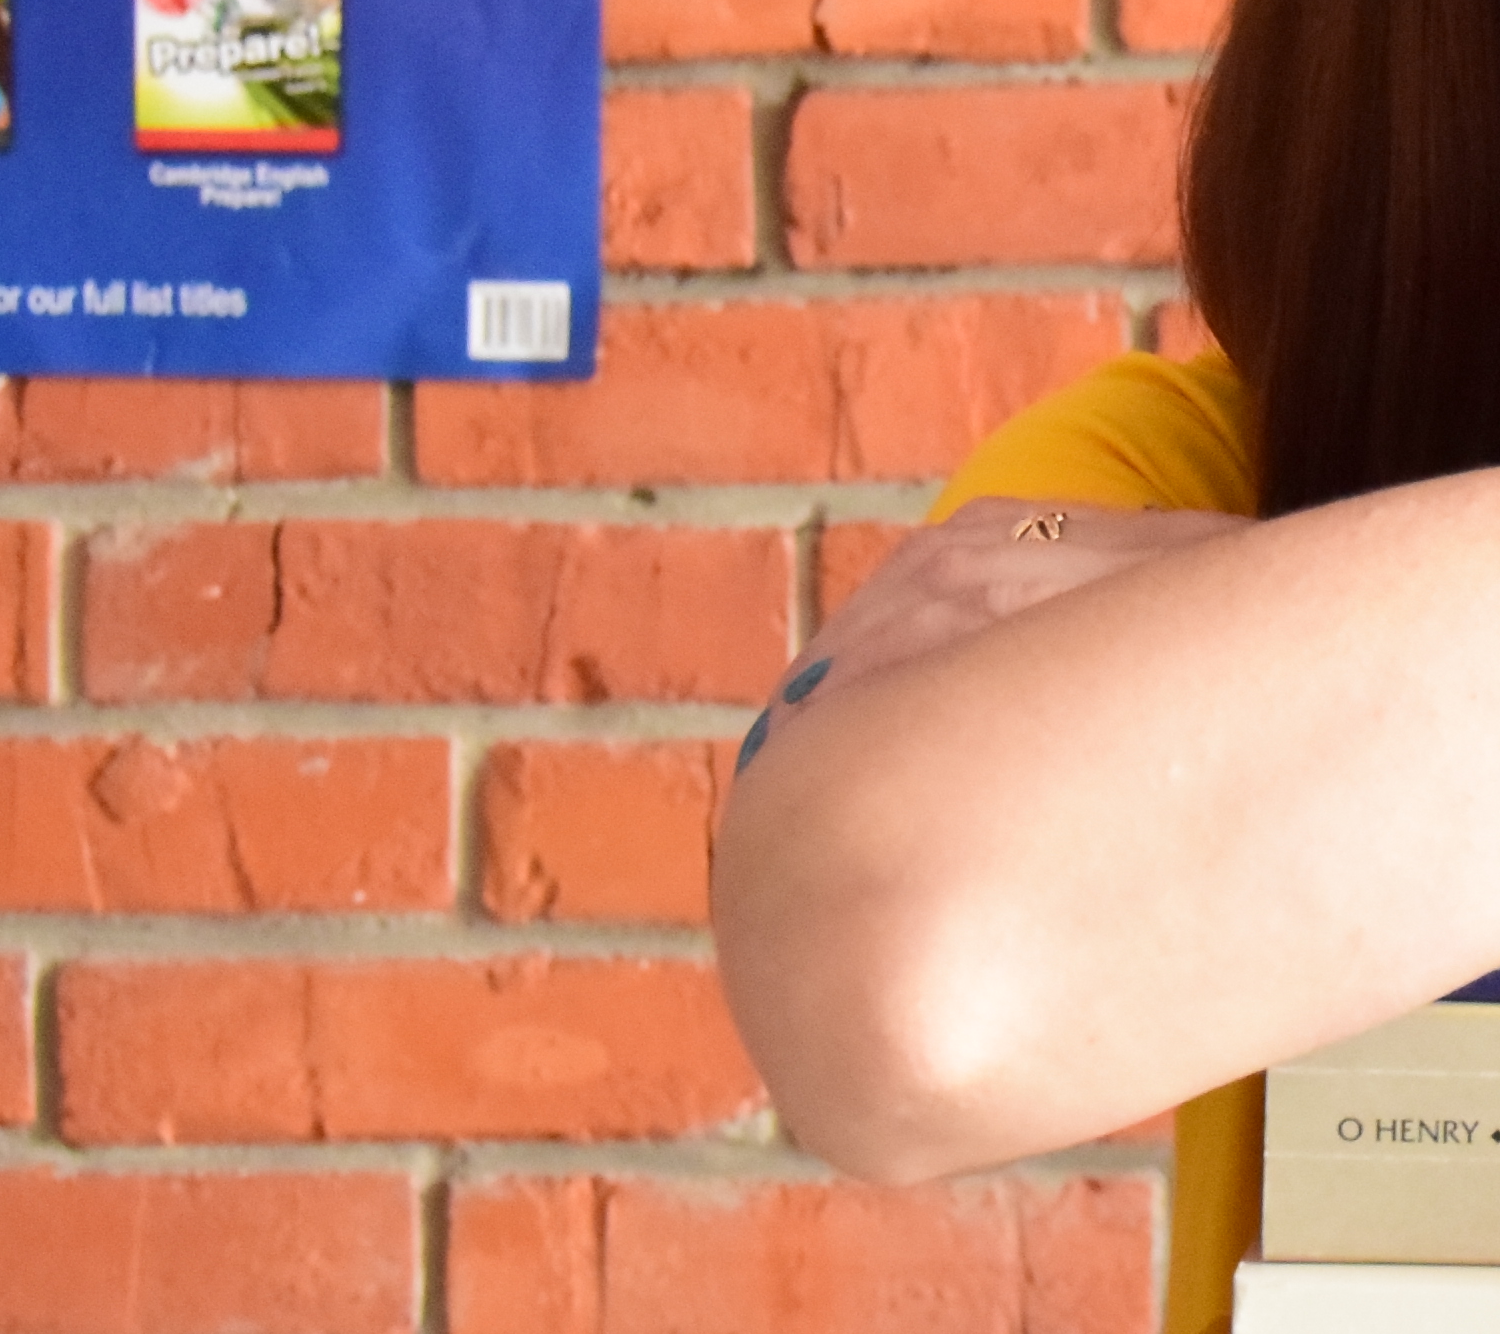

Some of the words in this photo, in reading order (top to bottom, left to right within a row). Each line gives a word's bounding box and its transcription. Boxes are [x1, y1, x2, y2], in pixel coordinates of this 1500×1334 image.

[148, 20, 320, 77] Prepare!
[149, 162, 250, 189] Cambridge
[256, 162, 329, 189] English
[27, 287, 75, 318] our
[82, 278, 127, 318] full
[132, 279, 172, 318] list
[178, 281, 247, 320] titles
[1336, 1116, 1365, 1143] O
[1374, 1118, 1480, 1146] HENRY
